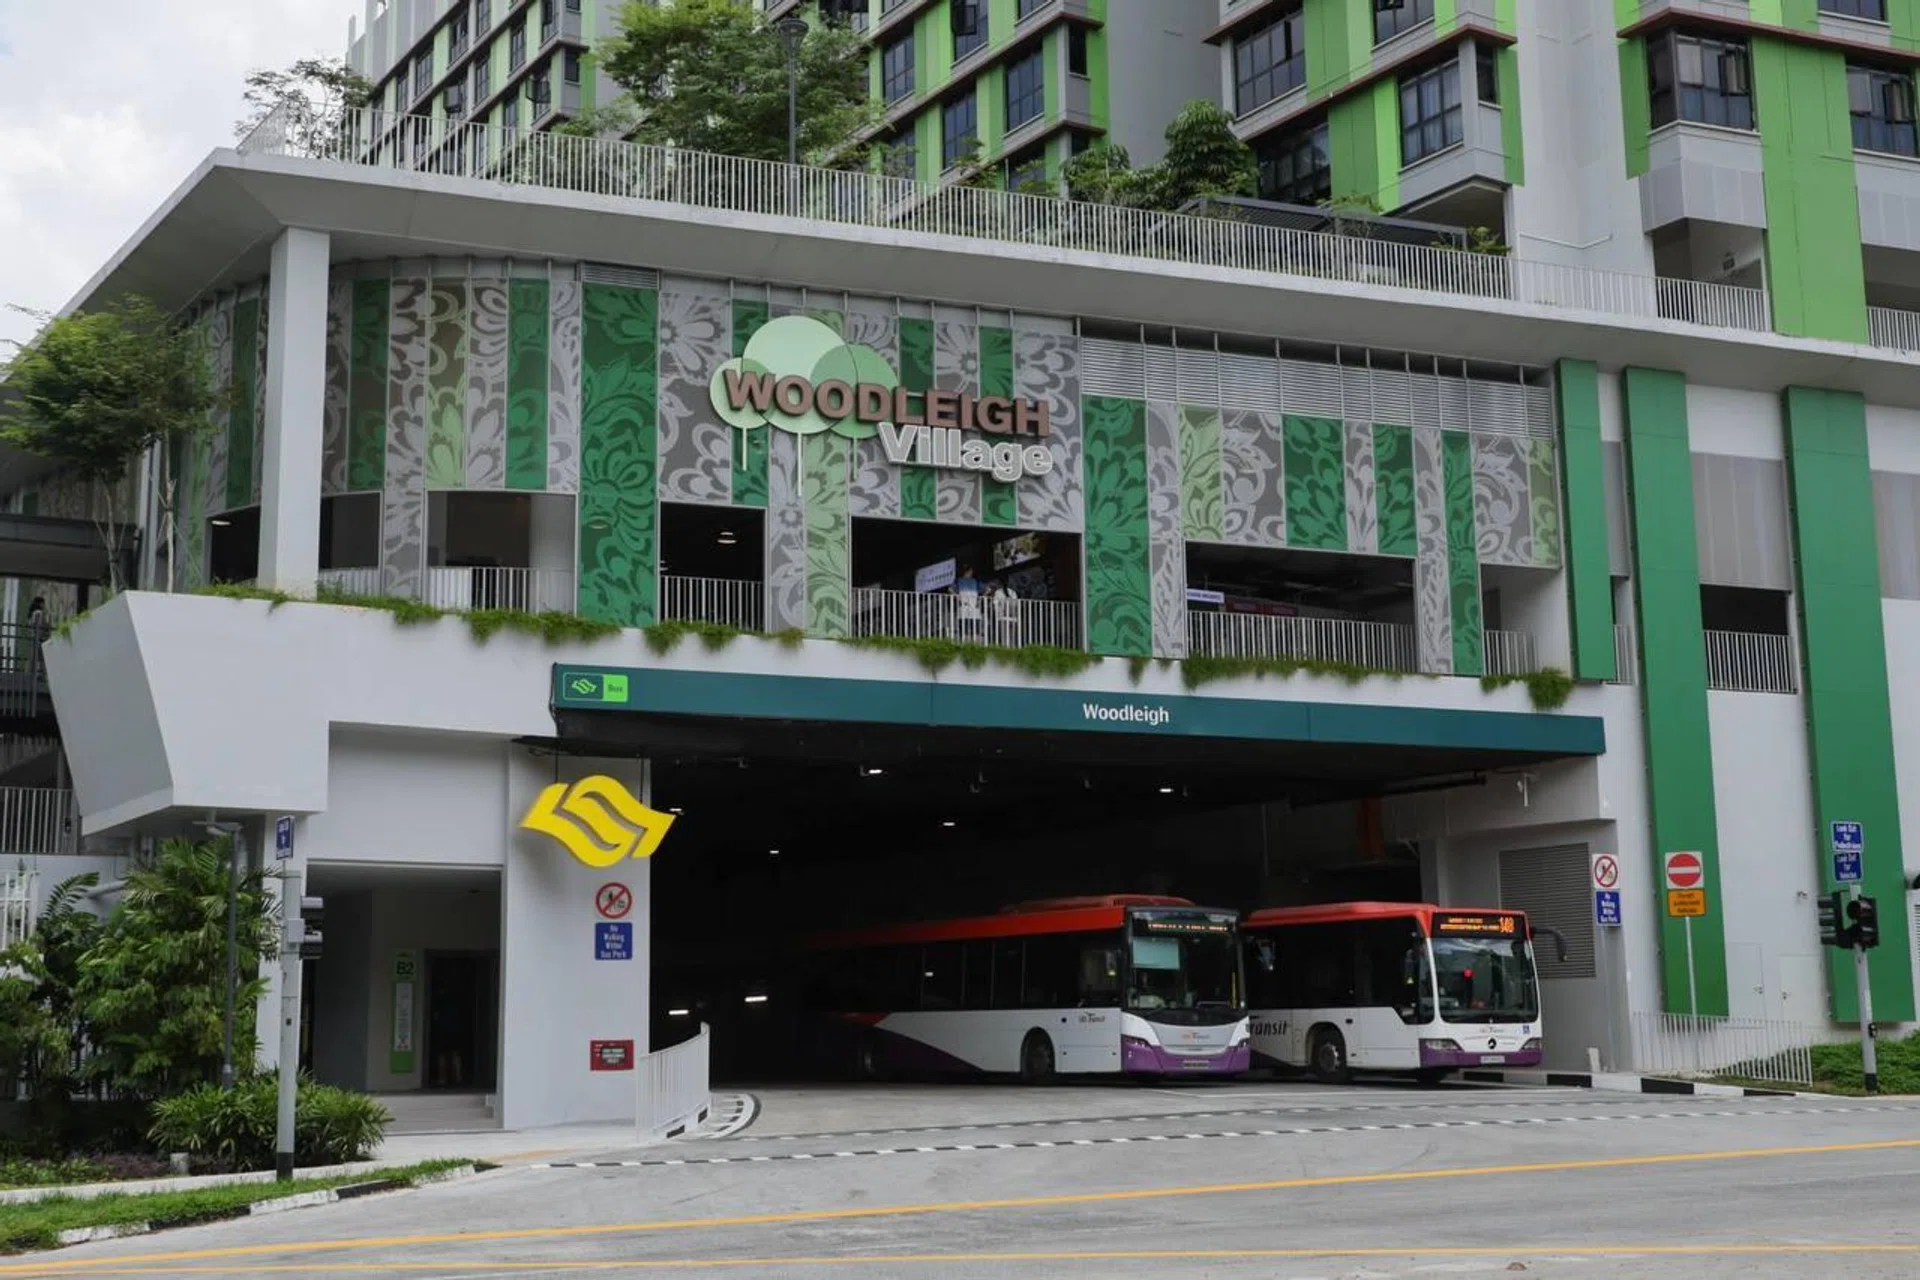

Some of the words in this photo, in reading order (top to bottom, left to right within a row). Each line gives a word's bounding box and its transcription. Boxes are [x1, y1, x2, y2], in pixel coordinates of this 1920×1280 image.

[723, 369, 1051, 437] WOODLEIGH
[878, 421, 1053, 482] Village
[1083, 703, 1170, 726] Woodleigh
[396, 961, 415, 976] B2
